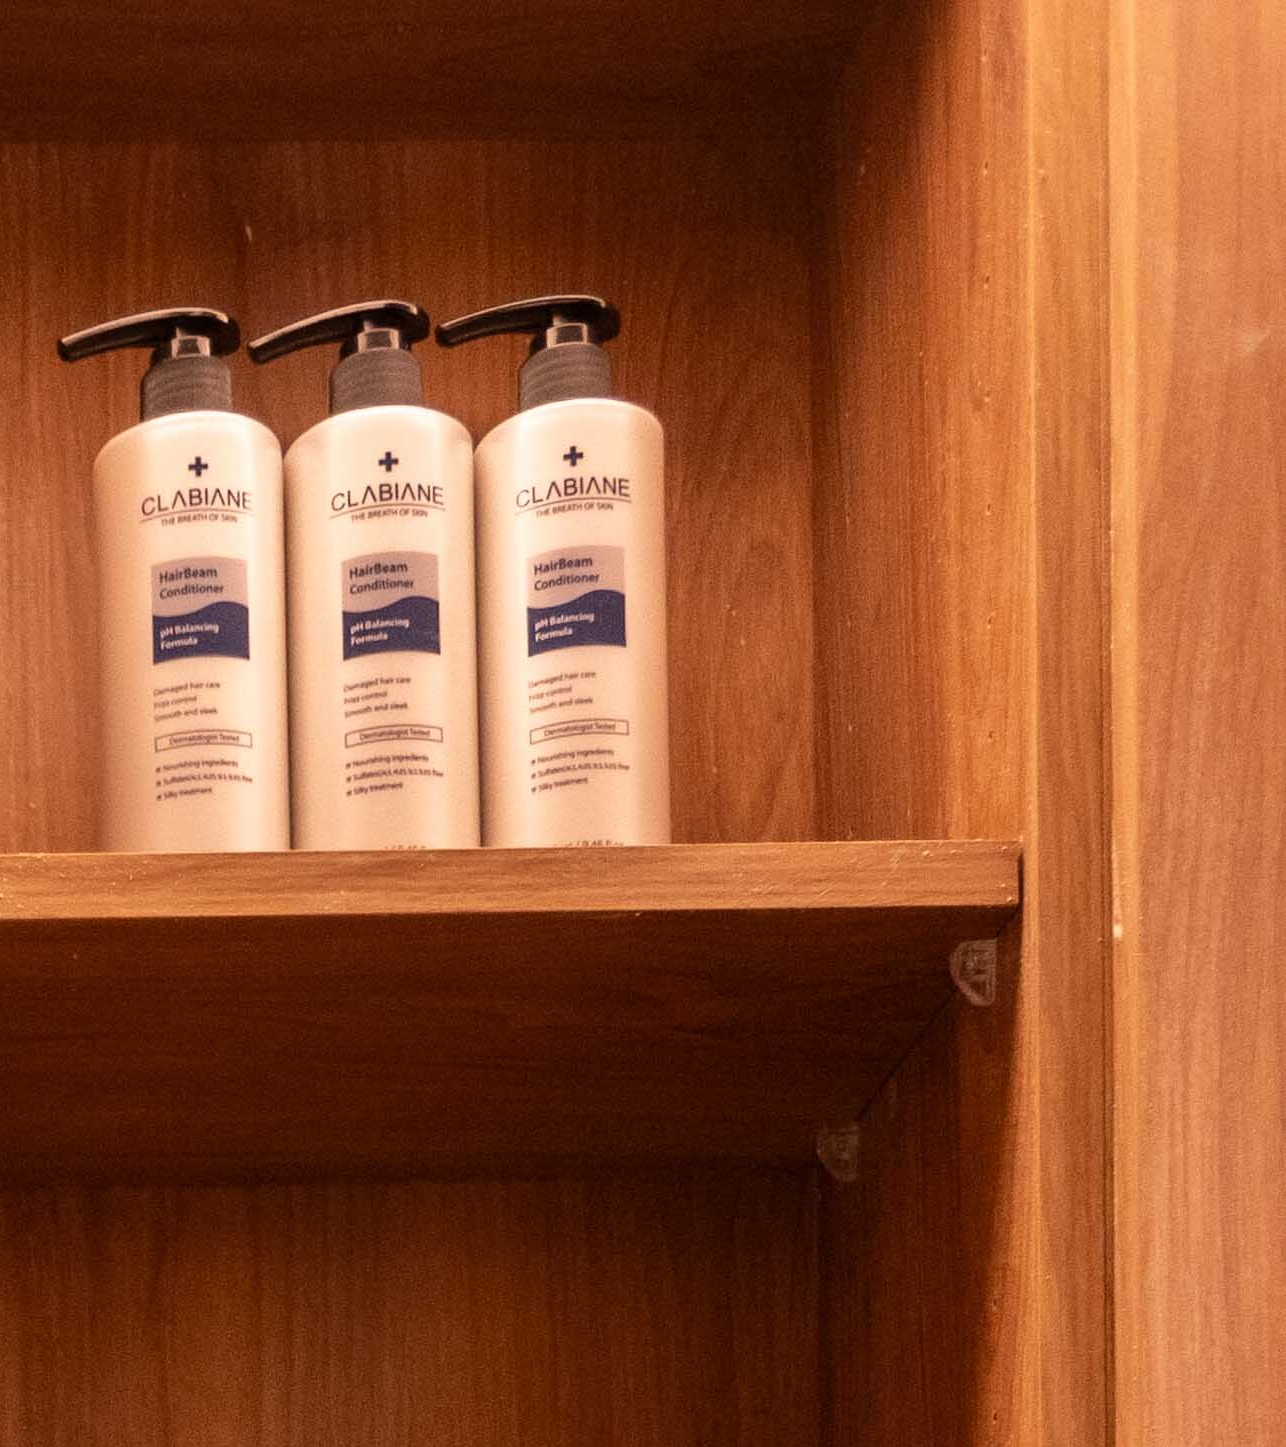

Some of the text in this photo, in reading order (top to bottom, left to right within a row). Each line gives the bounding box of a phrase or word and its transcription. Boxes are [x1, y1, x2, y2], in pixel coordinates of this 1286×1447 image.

[141, 488, 252, 515] CLABIANE
[331, 484, 444, 512] CLABIANE
[516, 477, 630, 508] CLABIANE
[159, 567, 218, 584] HairBeam
[349, 562, 409, 580] HairBeam
[534, 557, 593, 576] HairBeam
[159, 583, 224, 600] Conditioner
[349, 577, 414, 595] Conditioner
[534, 573, 600, 592] Conditioner
[159, 623, 220, 640] pH Balancing
[350, 618, 410, 635] pH Balancing
[534, 613, 595, 632] pH Balancing
[160, 636, 198, 651] Formula
[350, 631, 388, 647] Formula
[534, 626, 574, 643] Formula
